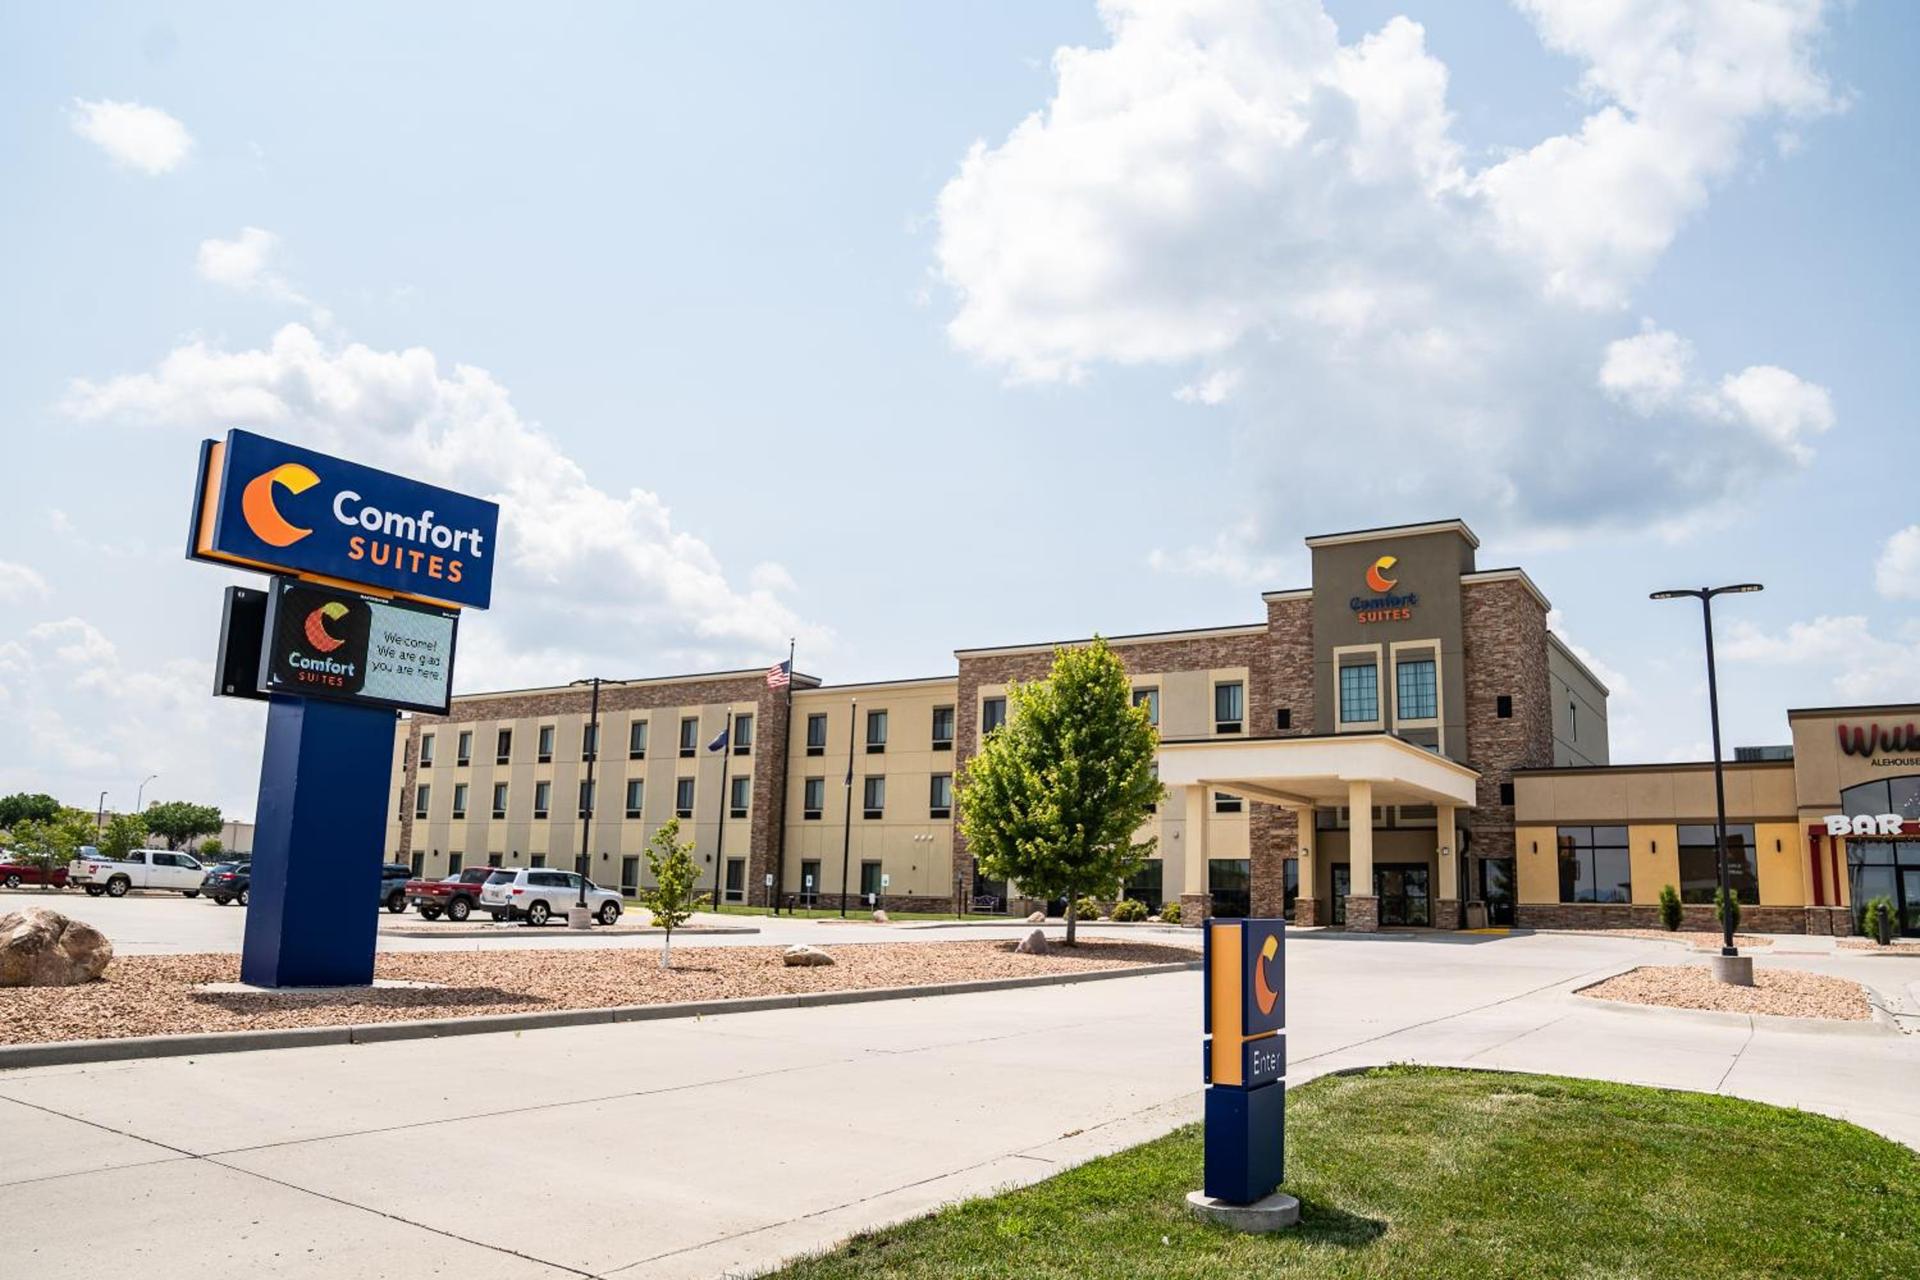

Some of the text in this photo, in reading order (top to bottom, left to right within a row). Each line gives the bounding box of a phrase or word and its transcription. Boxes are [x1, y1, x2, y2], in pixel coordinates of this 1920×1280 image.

[332, 490, 484, 558] Comfort
[348, 536, 464, 583] SUITES
[1350, 592, 1418, 611] Comfort
[1358, 608, 1411, 624] SUITES
[383, 630, 438, 652] Wecome!
[288, 651, 356, 677] Comfort
[377, 644, 441, 667] We are gad
[298, 671, 345, 687] SUITES
[371, 661, 393, 673] you
[396, 664, 414, 676] are
[1823, 813, 1904, 836] BAR
[1253, 1050, 1281, 1075] Enter
